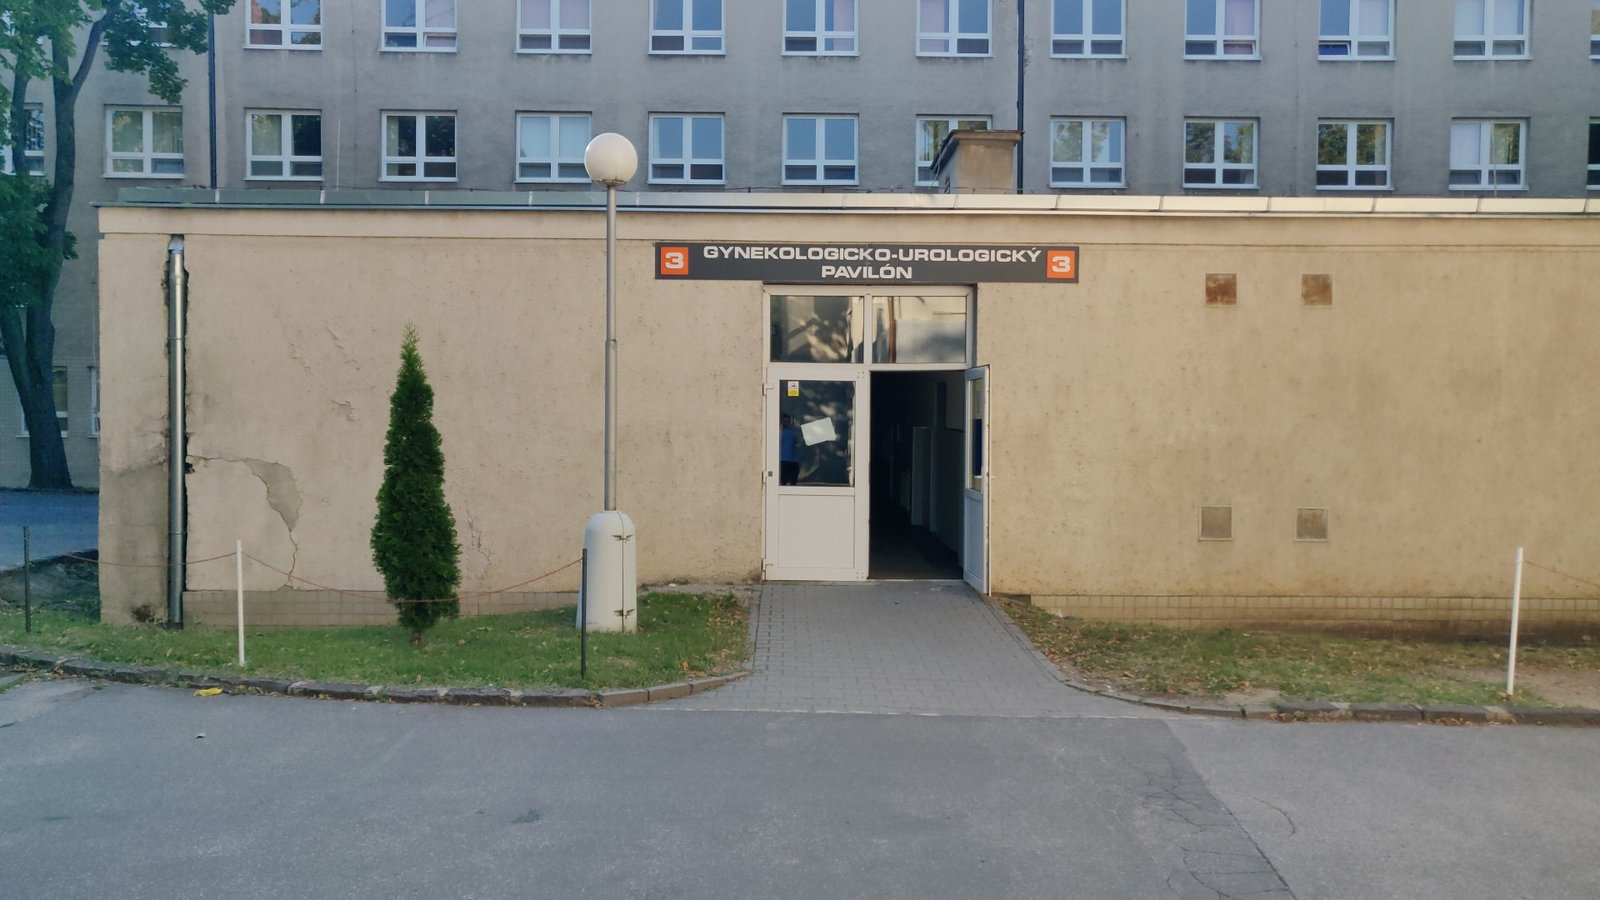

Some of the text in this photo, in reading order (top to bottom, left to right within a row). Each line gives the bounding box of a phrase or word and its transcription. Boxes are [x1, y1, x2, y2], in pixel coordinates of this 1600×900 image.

[665, 252, 684, 269] 3
[703, 245, 1042, 263] GYNEKOLOGICKO-UROLOGICKÝ
[822, 263, 913, 279] PAVILÓN
[1051, 255, 1072, 273] 3
